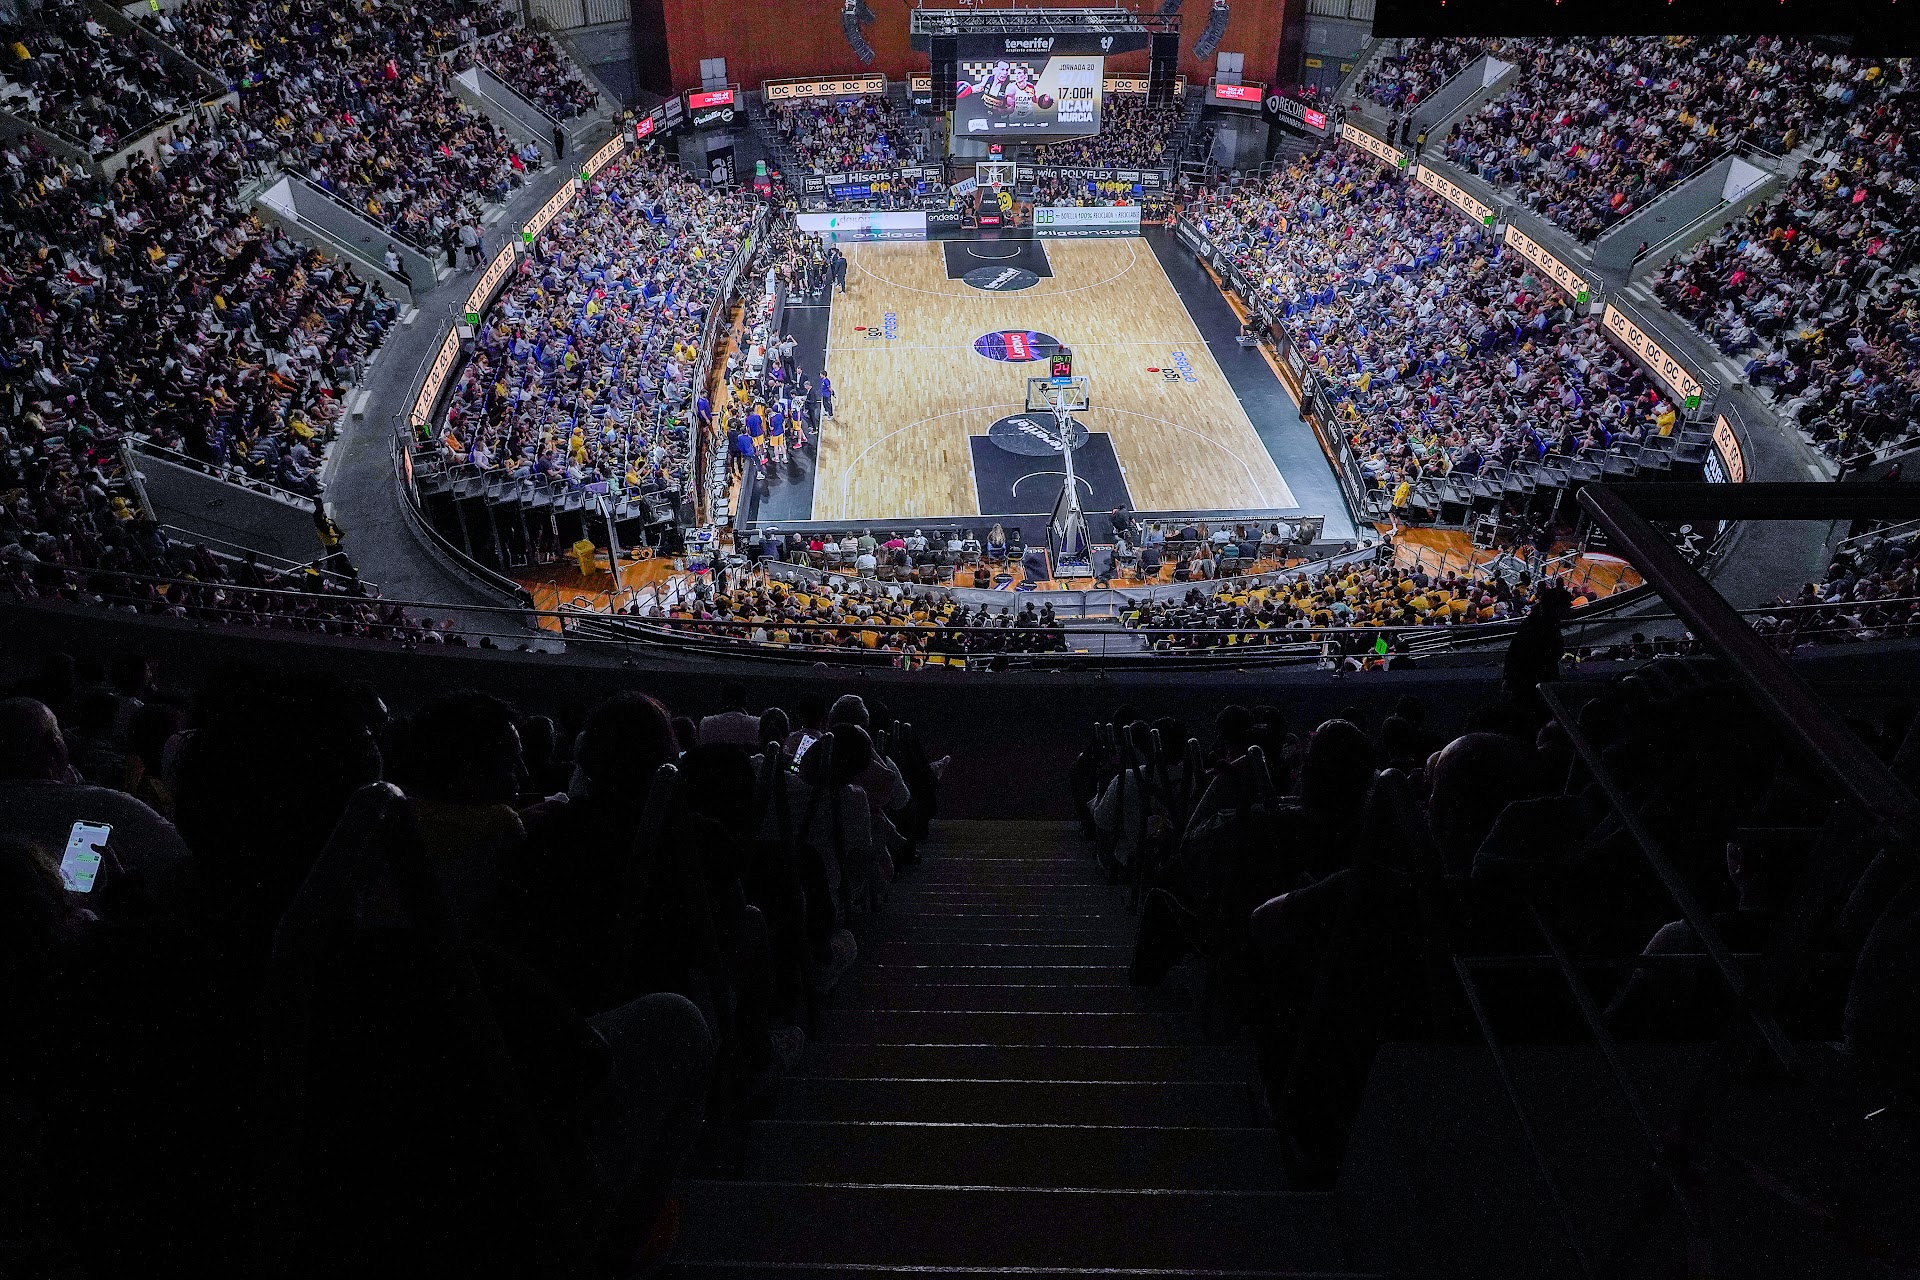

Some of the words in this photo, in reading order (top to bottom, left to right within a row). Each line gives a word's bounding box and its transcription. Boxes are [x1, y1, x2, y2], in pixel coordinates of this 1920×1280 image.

[771, 86, 789, 95] IOC
[795, 84, 813, 93] IOC
[818, 83, 836, 91] IOC
[842, 81, 860, 90] IOC
[866, 80, 883, 89] IOC
[1058, 87, 1093, 99] 17:00H
[1057, 100, 1093, 112] UCAM
[1279, 96, 1306, 118] RECOR
[1057, 112, 1093, 122] MURCIA
[990, 144, 1001, 153] 24
[1061, 169, 1113, 180] POLYFLEX
[959, 180, 976, 193] ADEJE
[1424, 170, 1434, 183] IOC
[1436, 178, 1447, 191] IOC
[1450, 187, 1460, 200] IOC
[1463, 196, 1473, 209] IOC
[928, 213, 959, 222] endesa
[1036, 210, 1055, 224] BB
[1037, 229, 1141, 237] #ligaendesa
[1511, 230, 1523, 246] IOC
[1526, 241, 1538, 257] IOC
[1540, 252, 1553, 269] IOC
[1555, 264, 1568, 281] IOC
[884, 312, 897, 340] endesa
[1010, 334, 1026, 358] Lenovo
[1611, 311, 1625, 331] IOC
[1628, 326, 1643, 346] IOC
[1645, 342, 1661, 363] IOC
[1663, 358, 1679, 380] IOC
[1054, 363, 1070, 376] 24
[1171, 351, 1198, 383] endesa
[1162, 368, 1180, 383] liga
